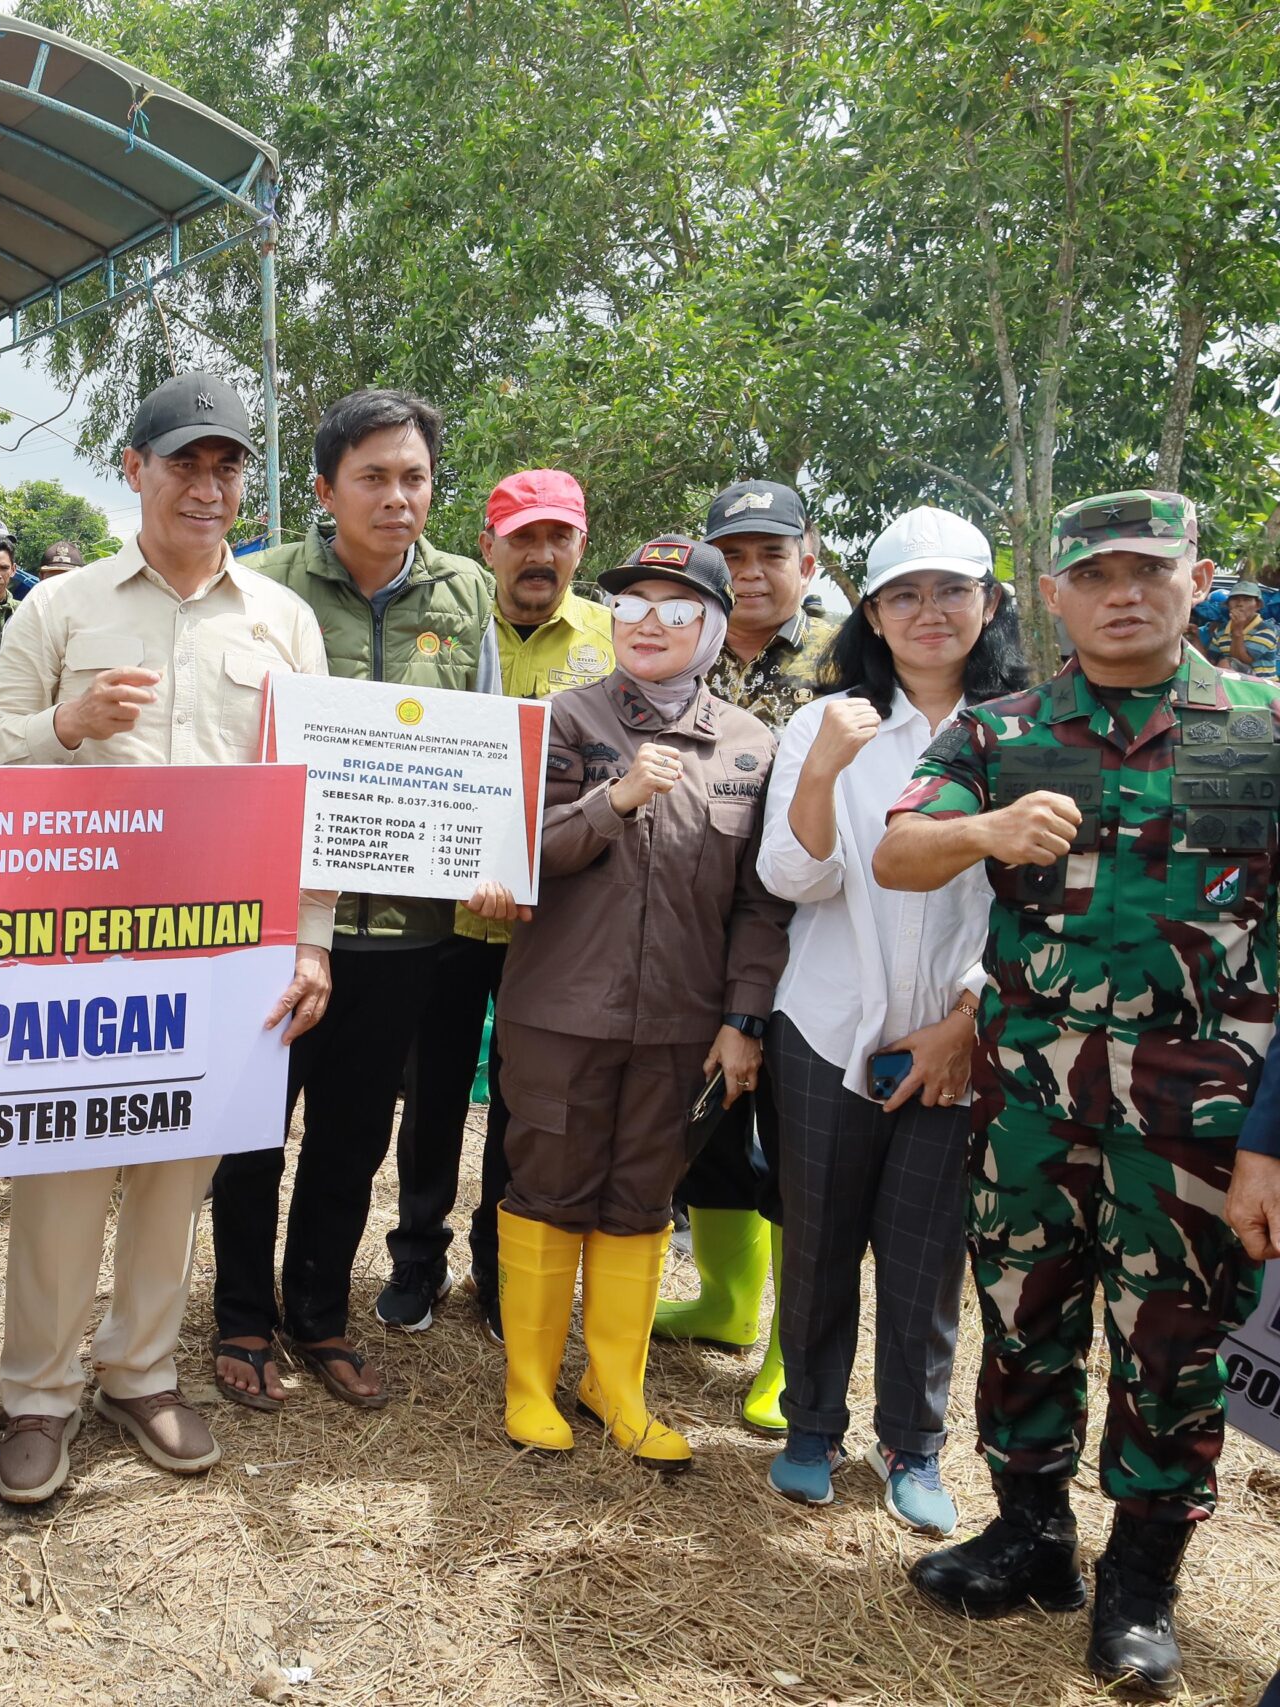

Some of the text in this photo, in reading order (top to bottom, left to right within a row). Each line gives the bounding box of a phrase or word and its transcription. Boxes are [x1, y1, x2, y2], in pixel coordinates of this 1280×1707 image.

[303, 733, 508, 760] PROGRAM KEMENTERIAN PERTANIAN TA. 2024
[304, 723, 508, 750] PENYERAHAN BANTUAN ALSINTAN PRAPANEN
[343, 758, 463, 778] BRIGADE PANGAN
[360, 774, 448, 791] KALIMANTAN
[453, 782, 512, 797] SELATAN
[1181, 778, 1276, 799] TNI AD
[322, 789, 374, 802] SEBESAR
[377, 795, 394, 805] Rp.
[22, 809, 164, 835] PERTANIAN
[316, 812, 325, 821] 1.
[329, 813, 382, 826] TRAKTOR
[386, 819, 416, 829] RODA
[419, 821, 426, 830] 4
[441, 823, 452, 832] 17
[456, 825, 483, 834] UNIT
[315, 824, 324, 832] 2.
[328, 825, 381, 837] TRAKTOR
[385, 830, 415, 840] RODA
[418, 833, 425, 841] 2
[439, 834, 452, 843] 34
[455, 836, 482, 845] UNIT
[314, 835, 323, 844] 3.
[327, 836, 365, 847] POMPA
[369, 840, 388, 849] AIR
[438, 846, 451, 855] 43
[455, 847, 481, 857] UNIT
[312, 847, 322, 856] 4.
[326, 848, 409, 862] HANDSPRAYER
[437, 857, 450, 866] 30
[454, 858, 480, 868] UNIT
[312, 858, 321, 867] 5.
[325, 859, 415, 874] TRANSPLANTER
[443, 868, 450, 877] 4
[453, 870, 480, 879] UNIT
[63, 902, 263, 954] PERTANIAN
[84, 1089, 192, 1139] BESAR
[1224, 1353, 1280, 1419] CO
